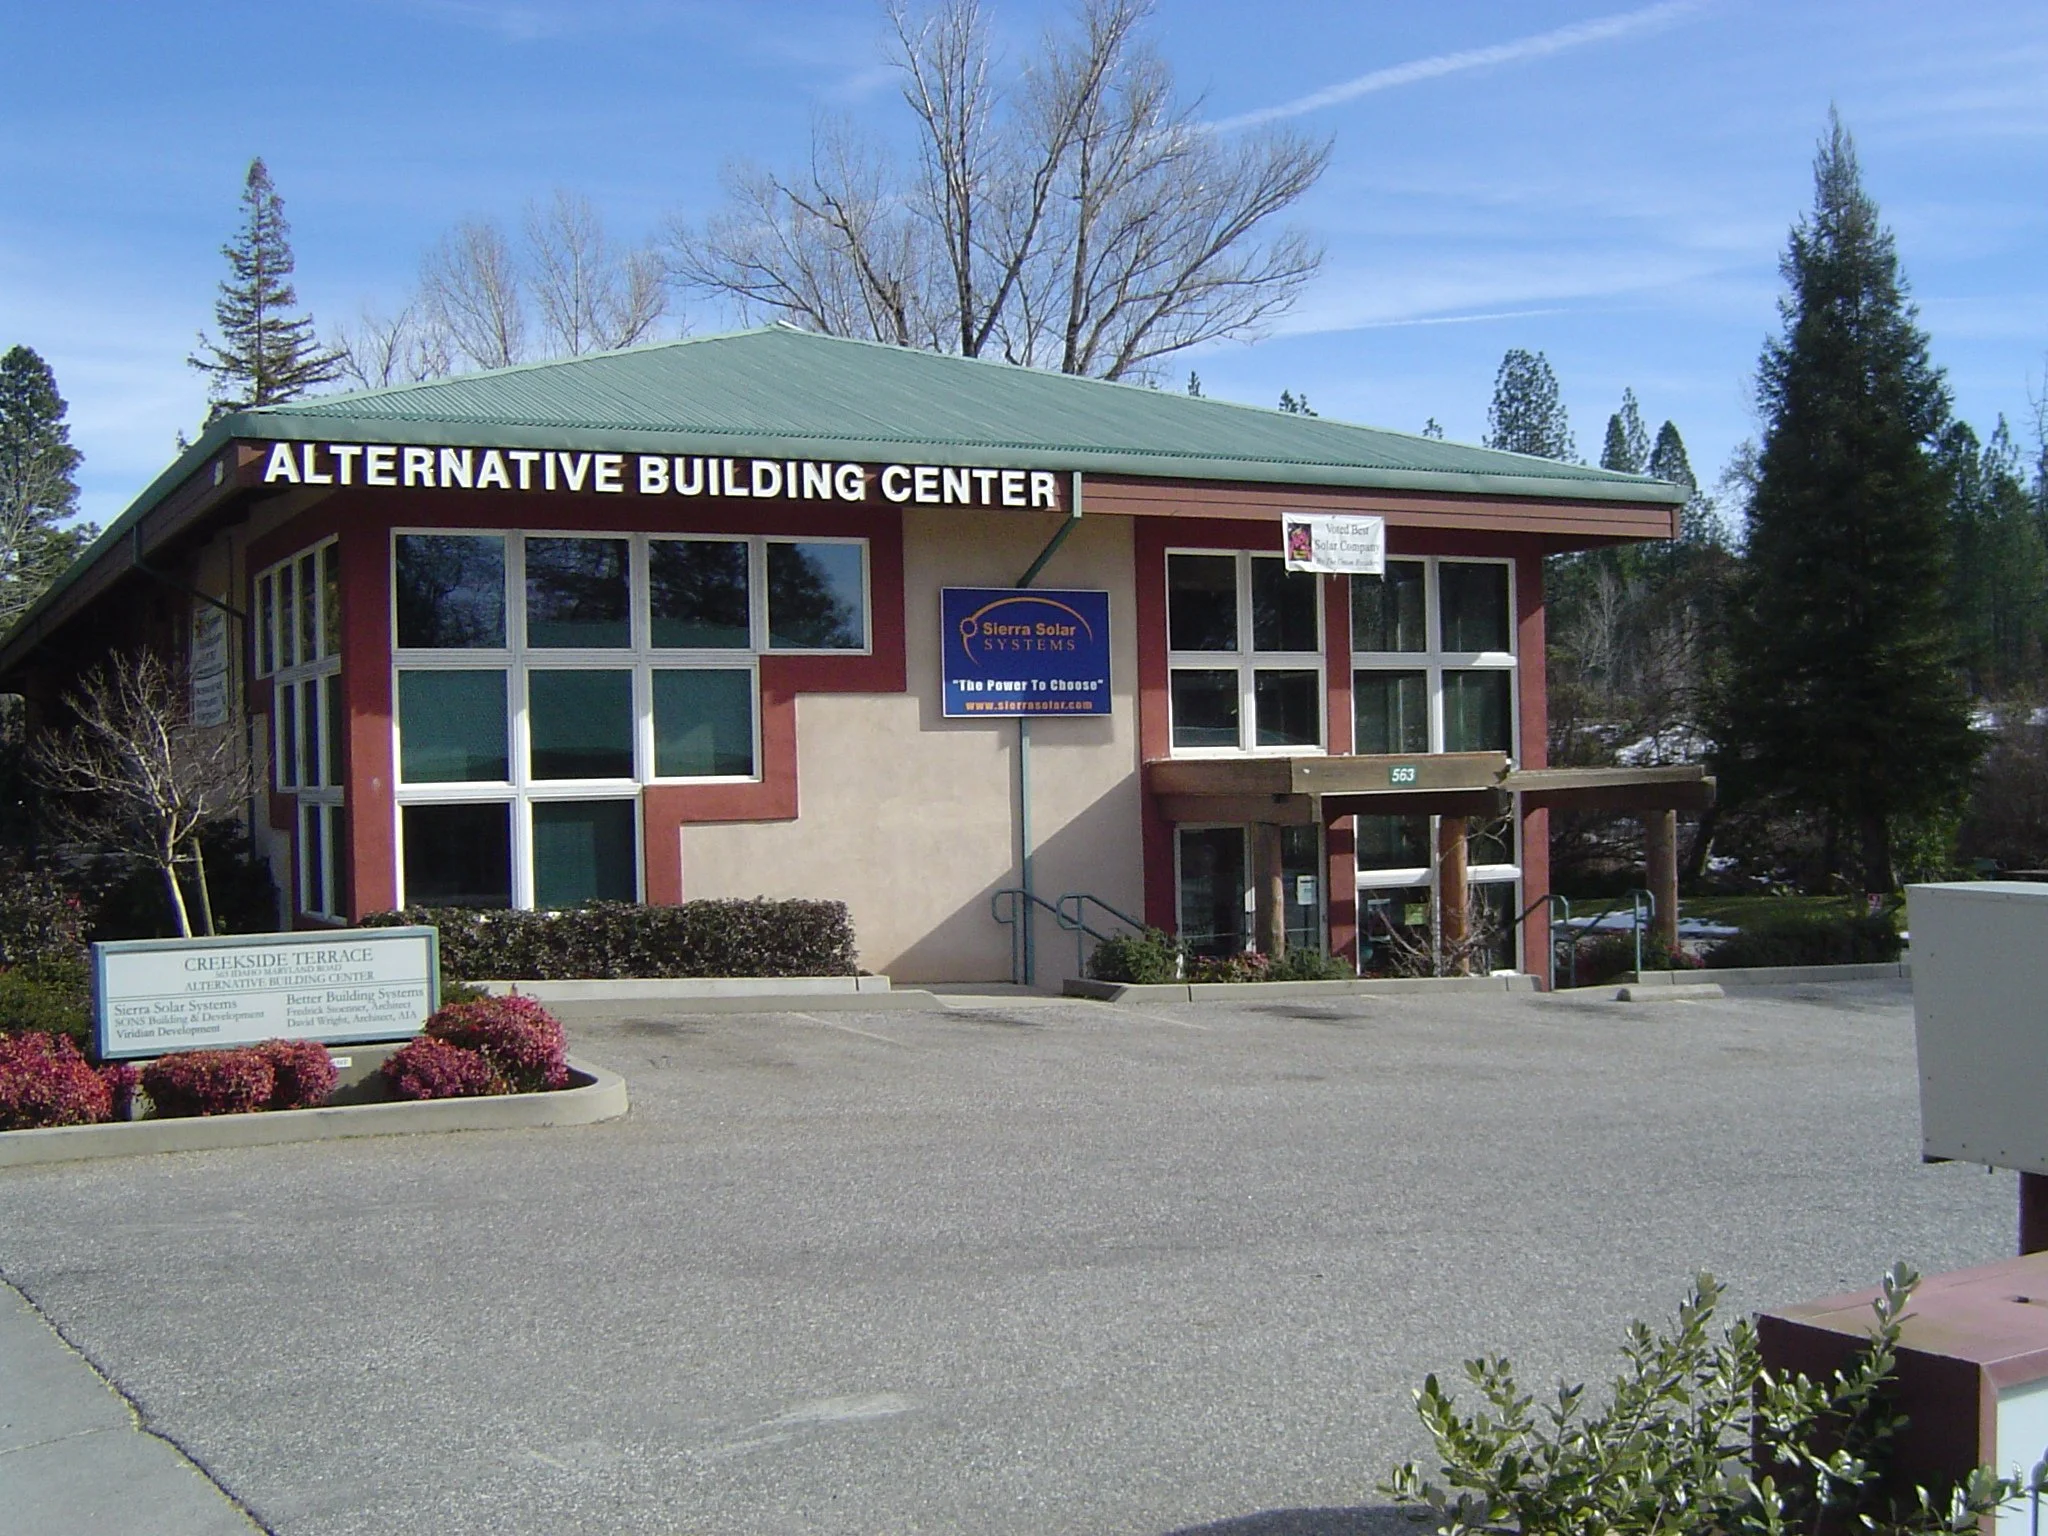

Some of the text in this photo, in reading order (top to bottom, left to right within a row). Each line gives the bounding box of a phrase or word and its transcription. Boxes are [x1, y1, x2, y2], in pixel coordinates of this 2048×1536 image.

[264, 442, 1057, 508] ALTERNATIVE BUILDING CENTER
[1326, 523, 1349, 535] Voted
[1314, 539, 1380, 554] Solar Company
[982, 622, 1076, 636] Sierra Solar
[984, 639, 1076, 650] SYSTEMS
[987, 679, 1028, 691] Power
[1031, 679, 1046, 691] To
[965, 700, 1093, 711] www.sierrasolar.com
[1392, 768, 1415, 781] 563
[184, 948, 373, 971] CREEKSIDE TERRACE
[264, 965, 315, 975] MARYLAND
[316, 963, 342, 972] ROAD
[185, 971, 374, 992] ALTERNATIVE BUILDING CENTER
[287, 988, 423, 1006] Better Building Systems
[114, 999, 237, 1016] Sierra Solar Systems
[372, 1001, 411, 1011] Architect
[149, 1014, 188, 1026] Building
[190, 1012, 200, 1022] &
[202, 1009, 264, 1023] Development
[287, 1017, 315, 1027] David
[399, 1009, 417, 1020] AIA
[116, 1024, 220, 1039] Viridian Development
